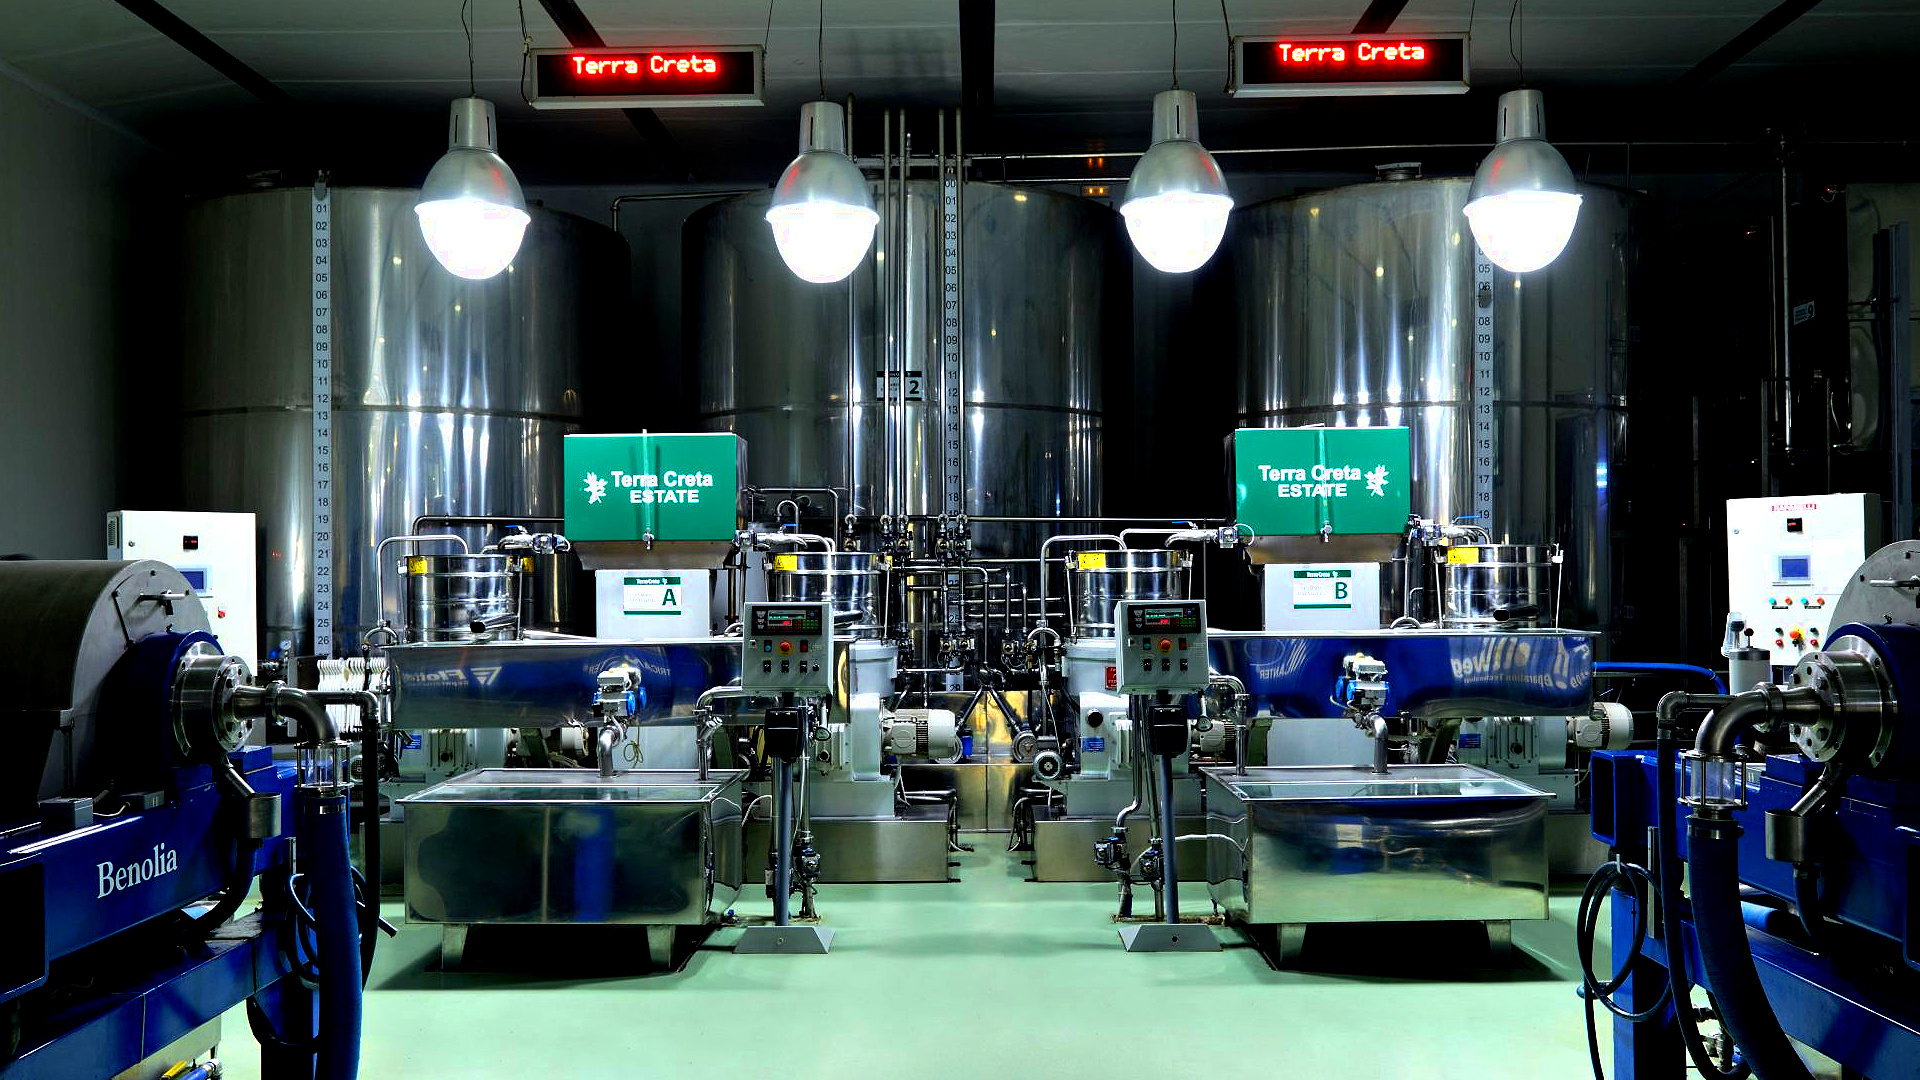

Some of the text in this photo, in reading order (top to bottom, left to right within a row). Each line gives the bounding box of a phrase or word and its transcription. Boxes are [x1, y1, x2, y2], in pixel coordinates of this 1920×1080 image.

[1279, 42, 1424, 62] Terra Creta
[573, 54, 716, 75] Terra Creta
[316, 204, 327, 213] 01
[316, 221, 327, 230] 02
[316, 238, 327, 247] 03
[316, 255, 327, 265] 04
[1478, 264, 1490, 273] 05
[316, 272, 327, 282] 05
[316, 290, 327, 299] 06
[316, 307, 327, 316] 07
[1478, 316, 1490, 326] 08
[316, 324, 327, 334] 08
[1478, 334, 1490, 343] 09
[316, 341, 327, 351] 09
[1479, 351, 1490, 361] 10
[318, 359, 328, 368] 10
[1479, 369, 1490, 378] 11
[318, 376, 328, 385] 11
[909, 380, 920, 394] 2
[1479, 387, 1490, 396] 12
[318, 393, 328, 402] 12
[1479, 404, 1490, 414] 13
[317, 411, 328, 420] 13
[1479, 422, 1490, 431] 14
[317, 428, 328, 437] 14
[1479, 440, 1490, 449] 15
[317, 445, 328, 455] 15
[1479, 457, 1490, 467] 16
[317, 463, 328, 472] 16
[1258, 465, 1361, 482] Terra Creta
[610, 471, 713, 487] Terra Creta
[1479, 475, 1490, 484] 17
[317, 480, 328, 489] 17
[1278, 483, 1347, 497] ESTATE
[630, 489, 700, 504] ESTATE
[1479, 492, 1490, 502] 18
[317, 497, 328, 507] 18
[317, 514, 328, 524] 19
[1479, 510, 1490, 520] 19
[317, 532, 329, 541] 20
[317, 549, 329, 558] 21
[317, 566, 329, 576] 22
[317, 584, 329, 593] 23
[1335, 581, 1348, 599] B
[662, 589, 677, 606] A
[317, 601, 329, 610] 24
[317, 618, 329, 627] 25
[317, 635, 329, 645] 26
[96, 842, 178, 899] Benolia
